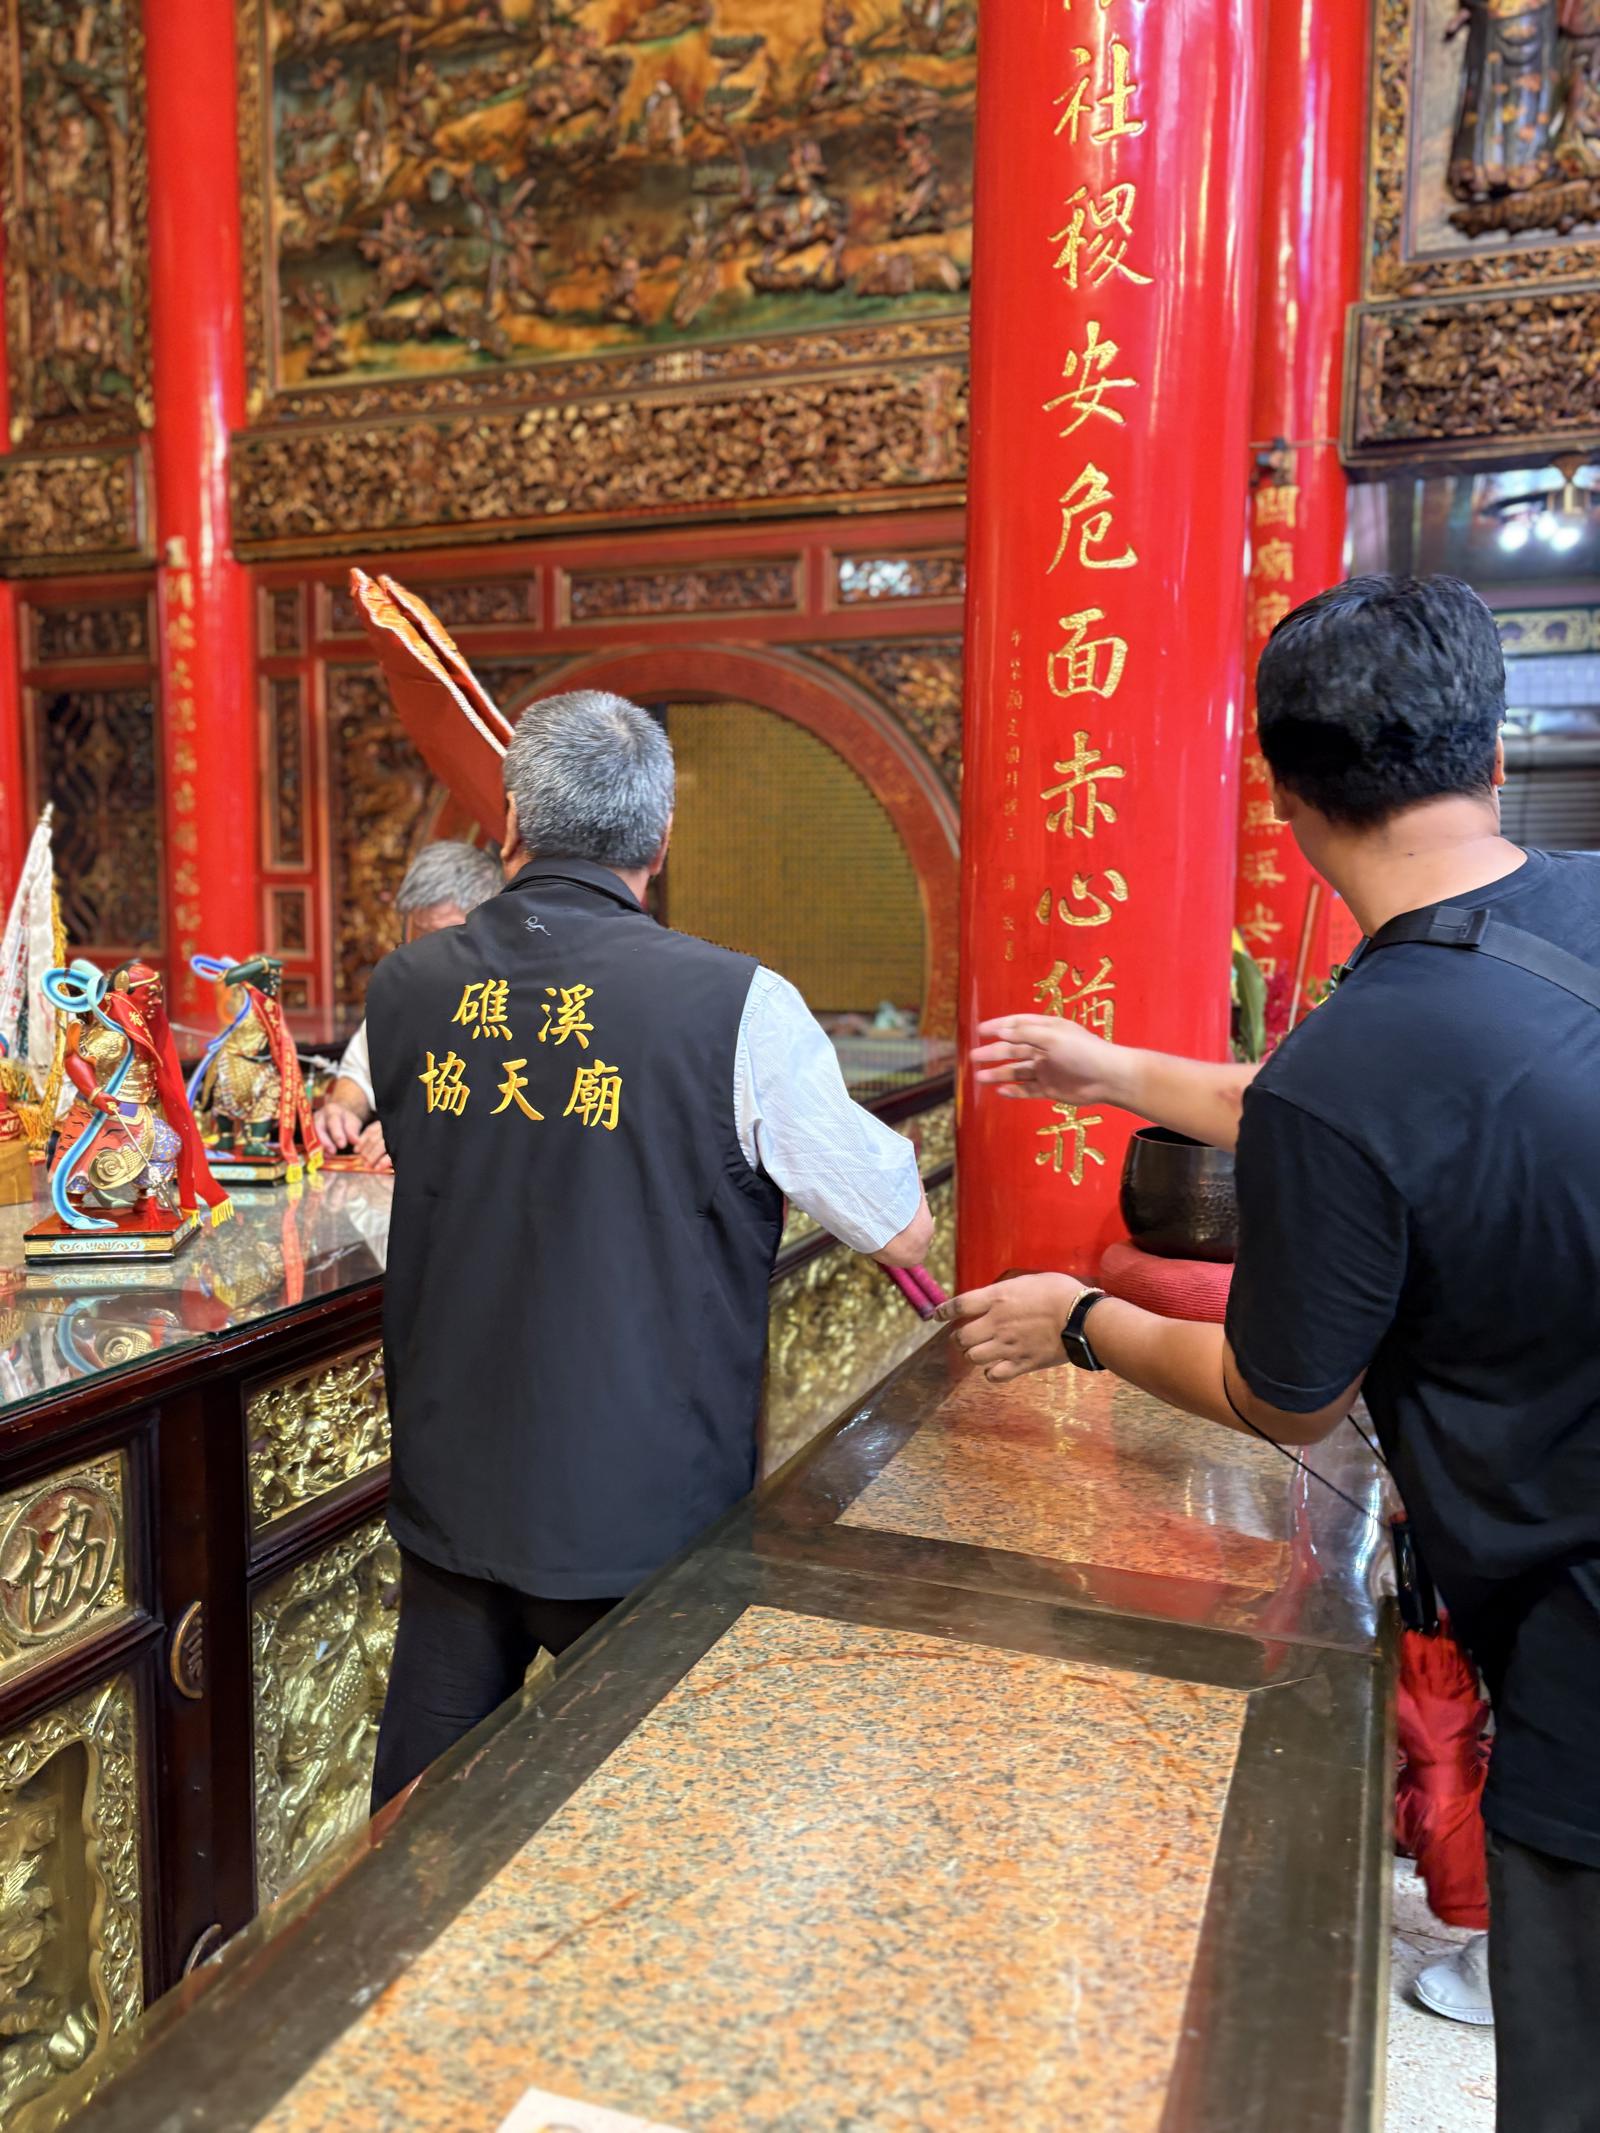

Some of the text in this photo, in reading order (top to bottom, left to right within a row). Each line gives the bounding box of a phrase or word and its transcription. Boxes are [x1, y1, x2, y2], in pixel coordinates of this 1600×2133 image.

[1033, 0, 1154, 1185] 社稷安危面赤心猶赤
[451, 979, 595, 1050] 礁溪
[418, 1051, 623, 1131] 協天廟
